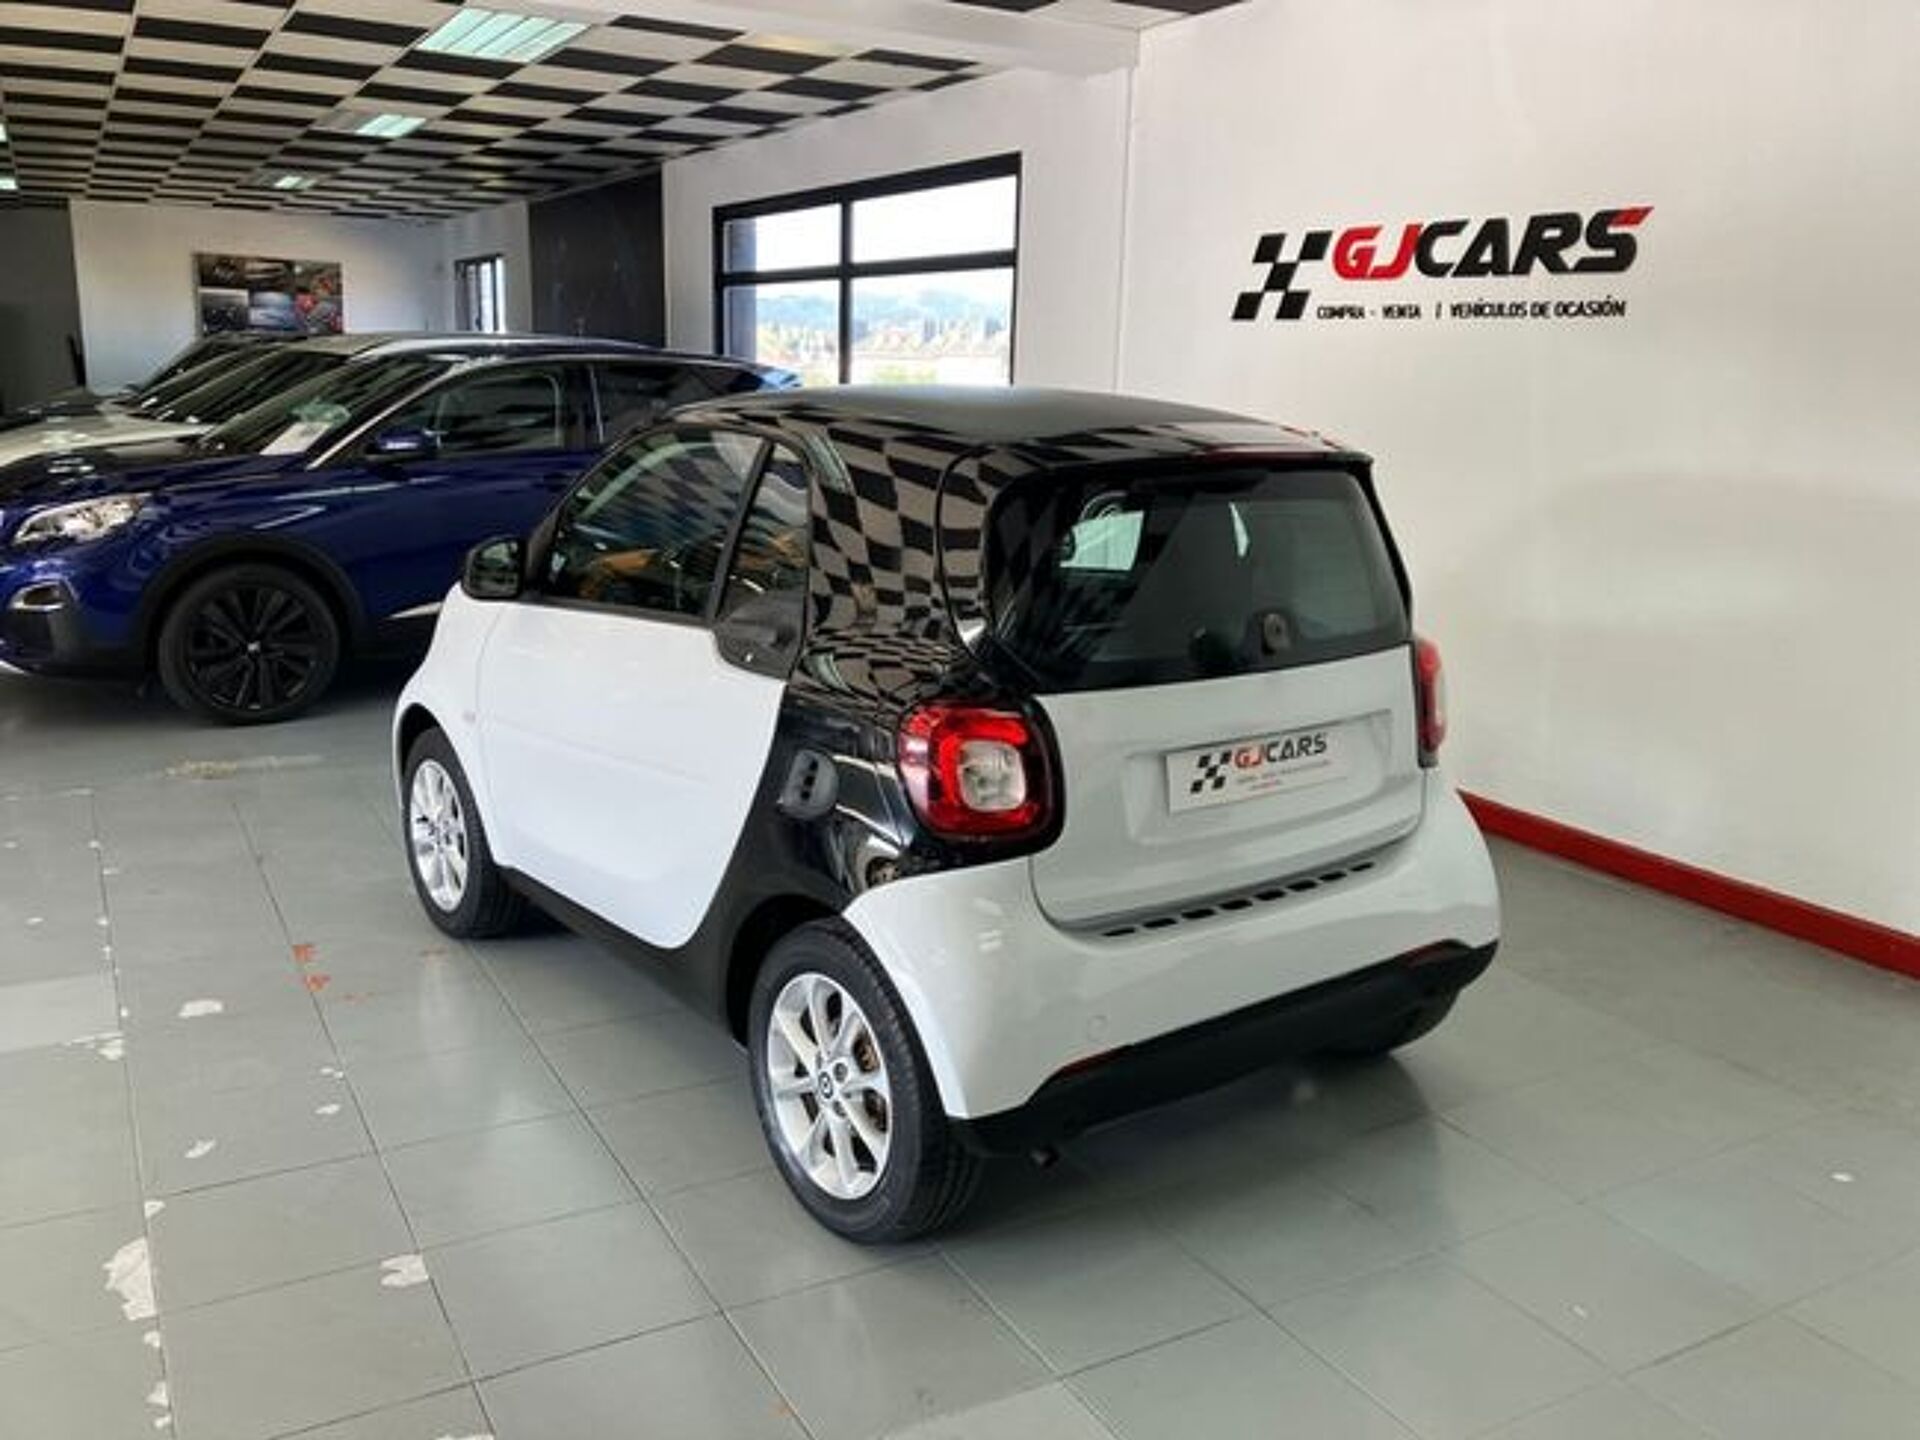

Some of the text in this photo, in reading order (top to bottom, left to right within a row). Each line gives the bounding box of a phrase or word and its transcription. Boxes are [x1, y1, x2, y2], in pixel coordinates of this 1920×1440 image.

[1332, 206, 1655, 280] GJCARS
[1530, 301, 1549, 317] DE
[1235, 733, 1327, 768] GJCARS
